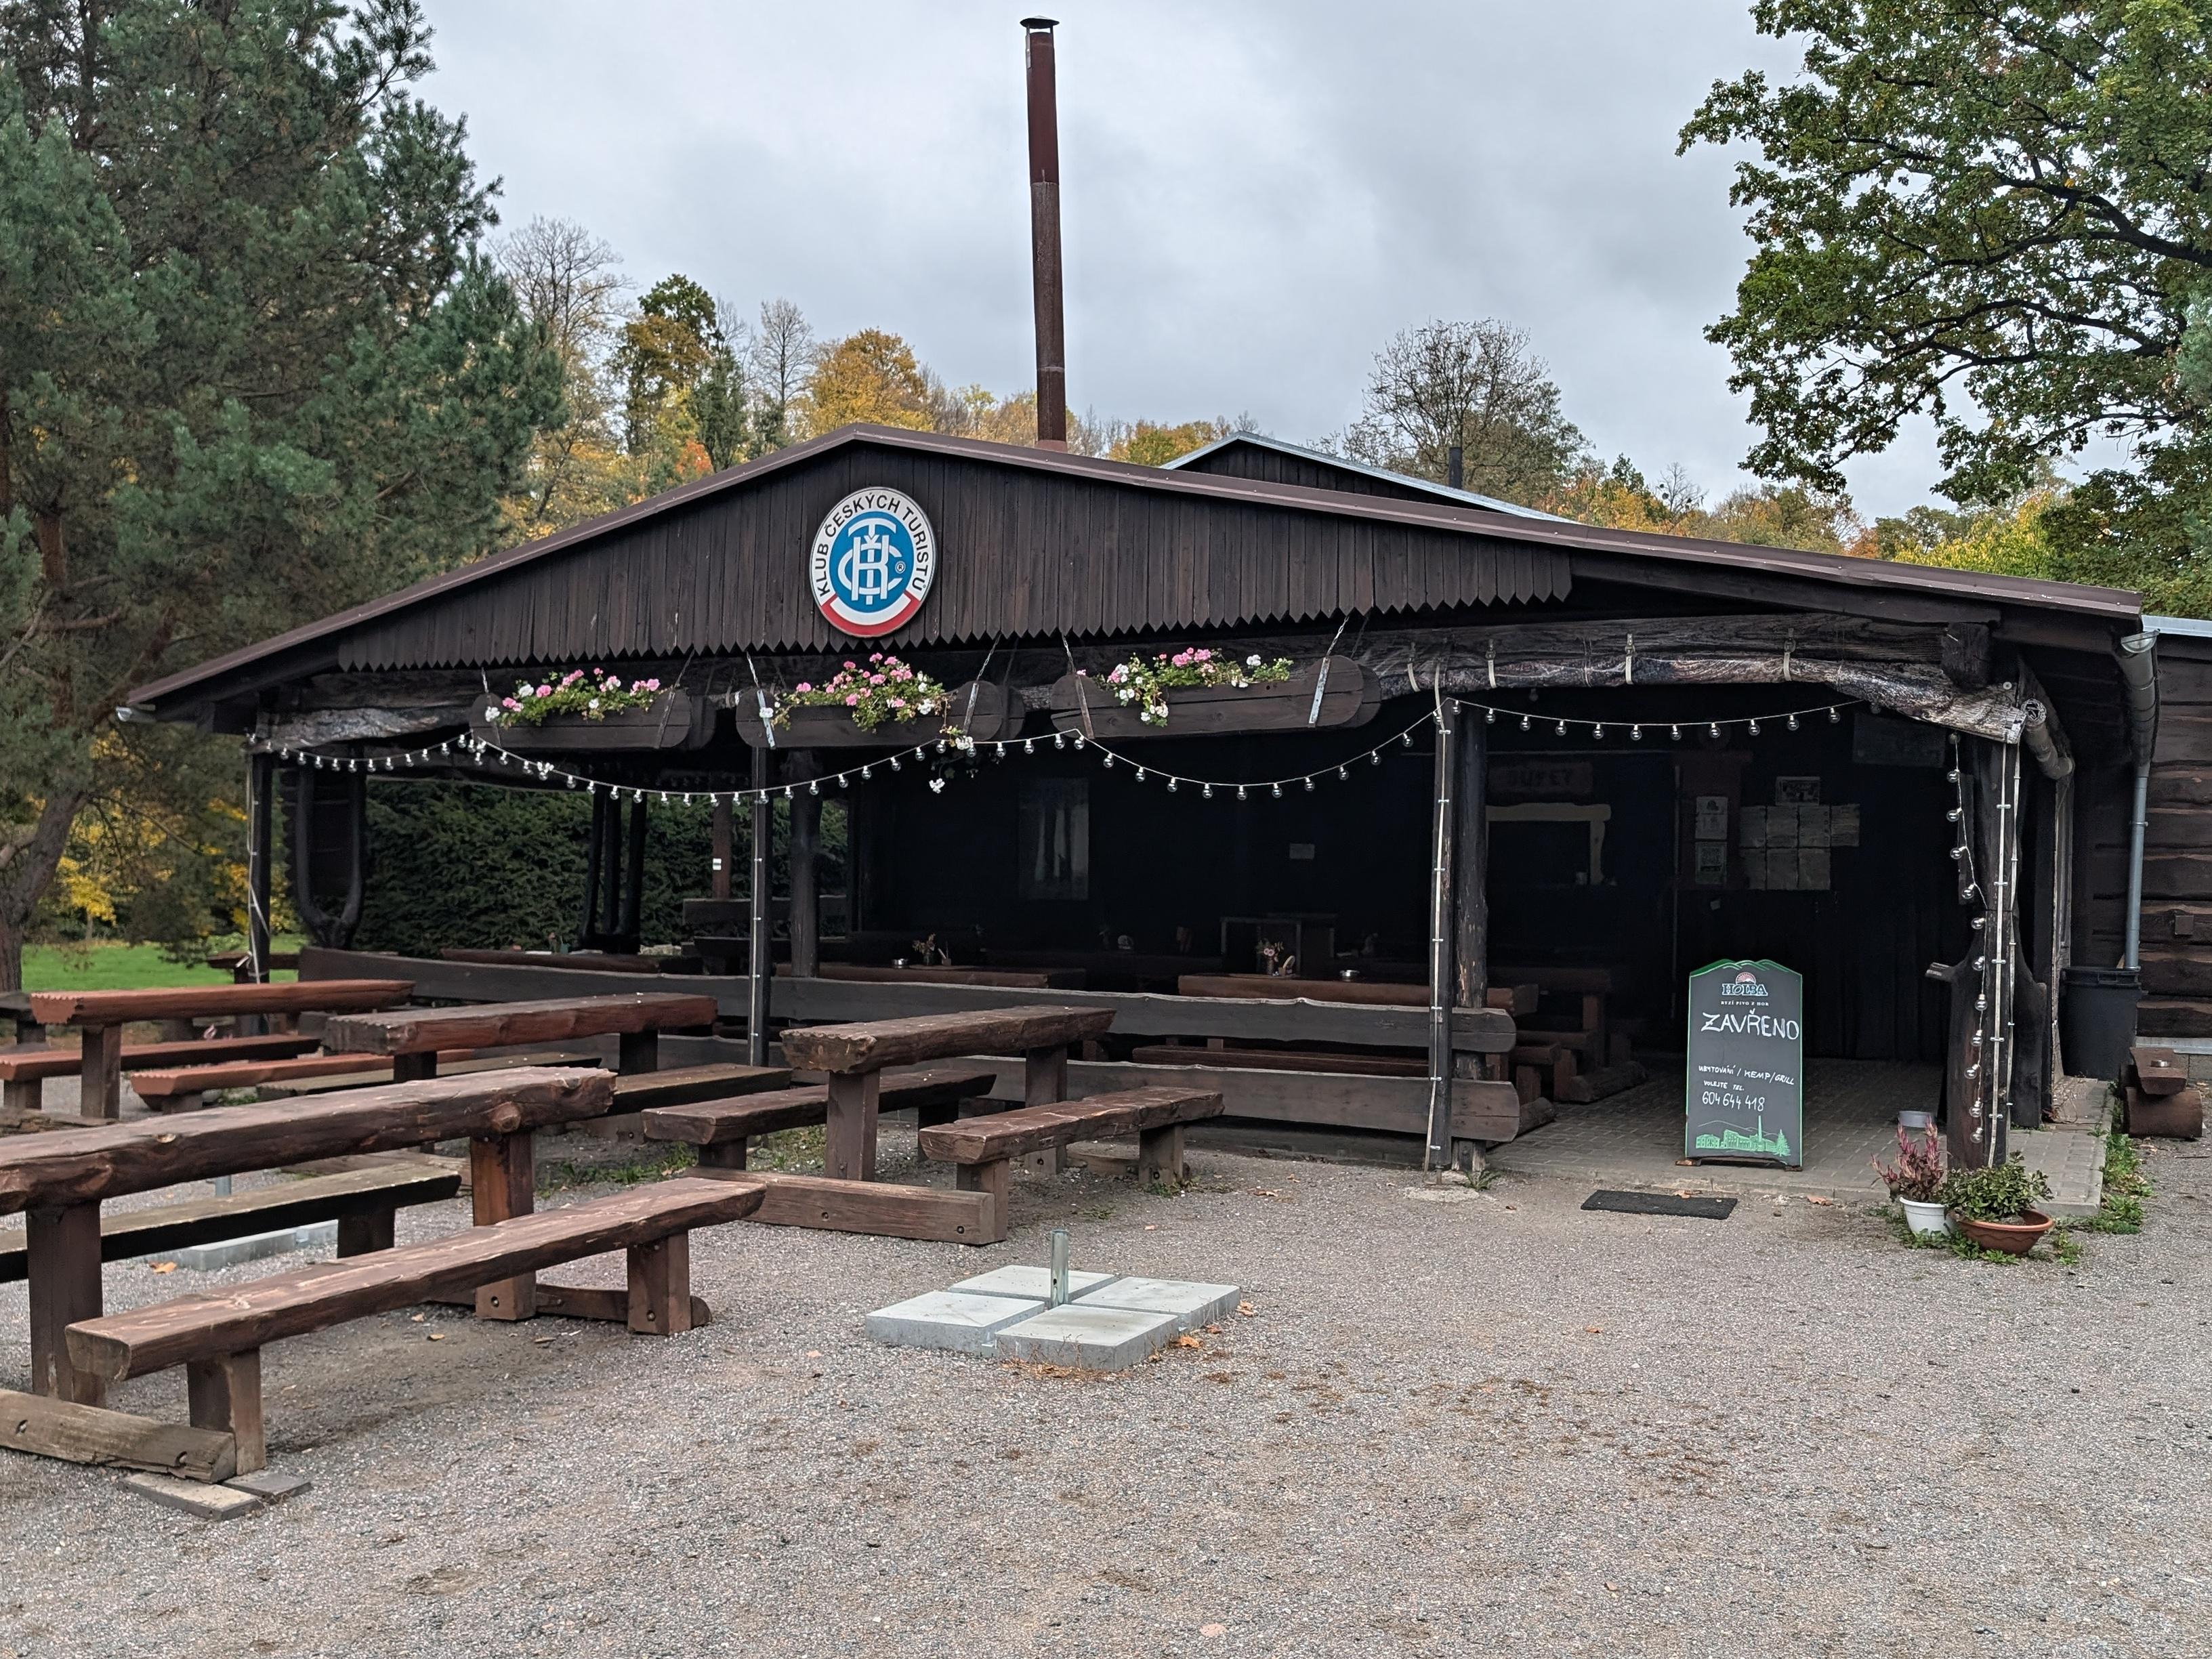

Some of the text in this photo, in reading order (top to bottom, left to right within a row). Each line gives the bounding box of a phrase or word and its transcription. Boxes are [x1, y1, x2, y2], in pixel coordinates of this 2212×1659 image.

[814, 492, 930, 597] KLUB ČESKÝCH TURISTŮ
[1721, 983, 1768, 996] HOLBA
[1700, 1008, 1799, 1040] ZAVŘENO
[1703, 1080, 1728, 1089] VOLEJTE
[1702, 1091, 1765, 1112] 604 644 418
